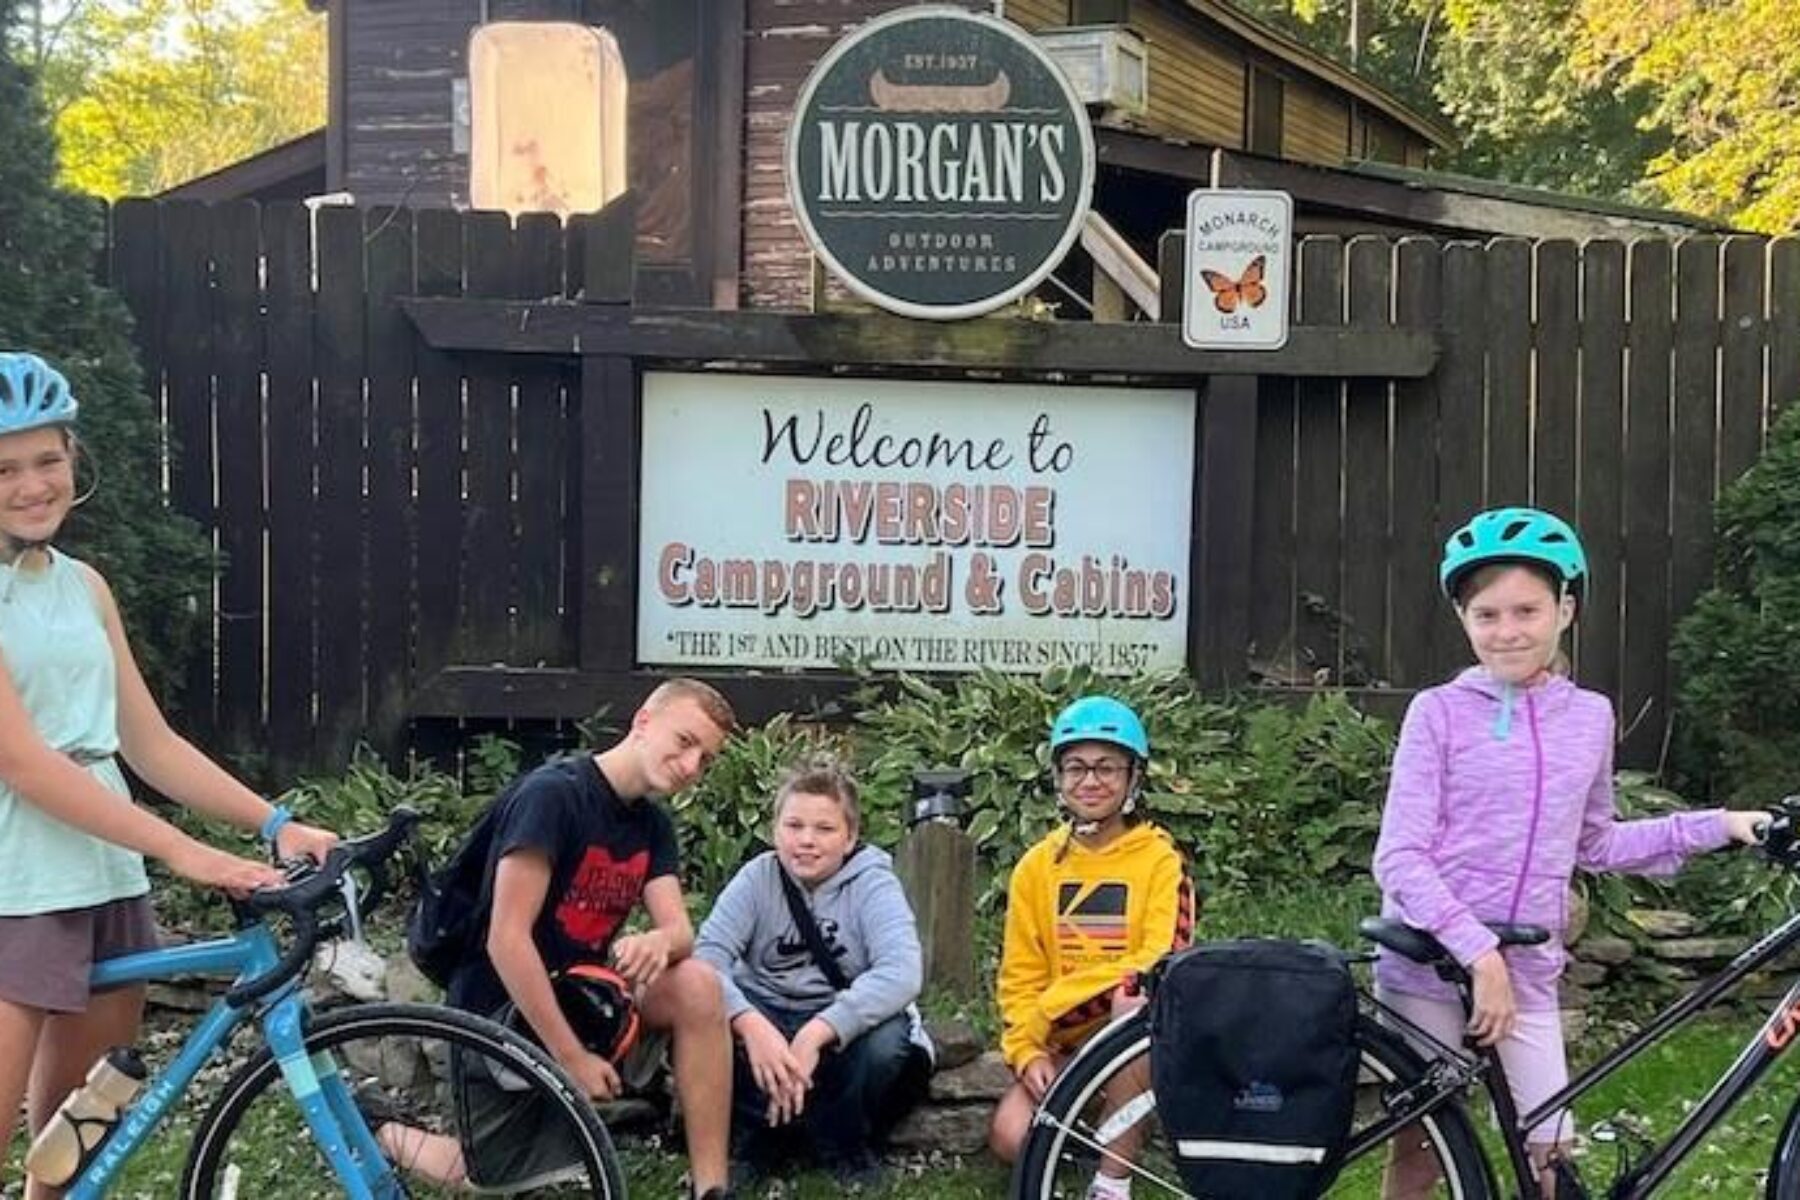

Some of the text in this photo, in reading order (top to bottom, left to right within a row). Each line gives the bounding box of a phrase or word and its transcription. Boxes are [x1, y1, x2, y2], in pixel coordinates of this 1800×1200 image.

[818, 121, 1066, 203] MORGAN'S
[888, 232, 993, 249] OUTDOOR
[1199, 211, 1280, 238] MONARCH
[867, 254, 1016, 272] ADVENTURES
[1199, 240, 1279, 254] CAMPGROUND
[1220, 316, 1250, 330] USA
[760, 402, 1074, 474] Welcome to
[784, 478, 1056, 548] RIVERSIDE
[657, 542, 1177, 619] Campground & Cabins
[761, 632, 809, 658] AND
[815, 634, 870, 660] BEST
[876, 637, 908, 661] ON
[912, 637, 957, 663] THE
[964, 639, 1032, 665] RIVER
[1037, 642, 1101, 667] SINCE
[90, 1080, 174, 1185] RALEIGH
